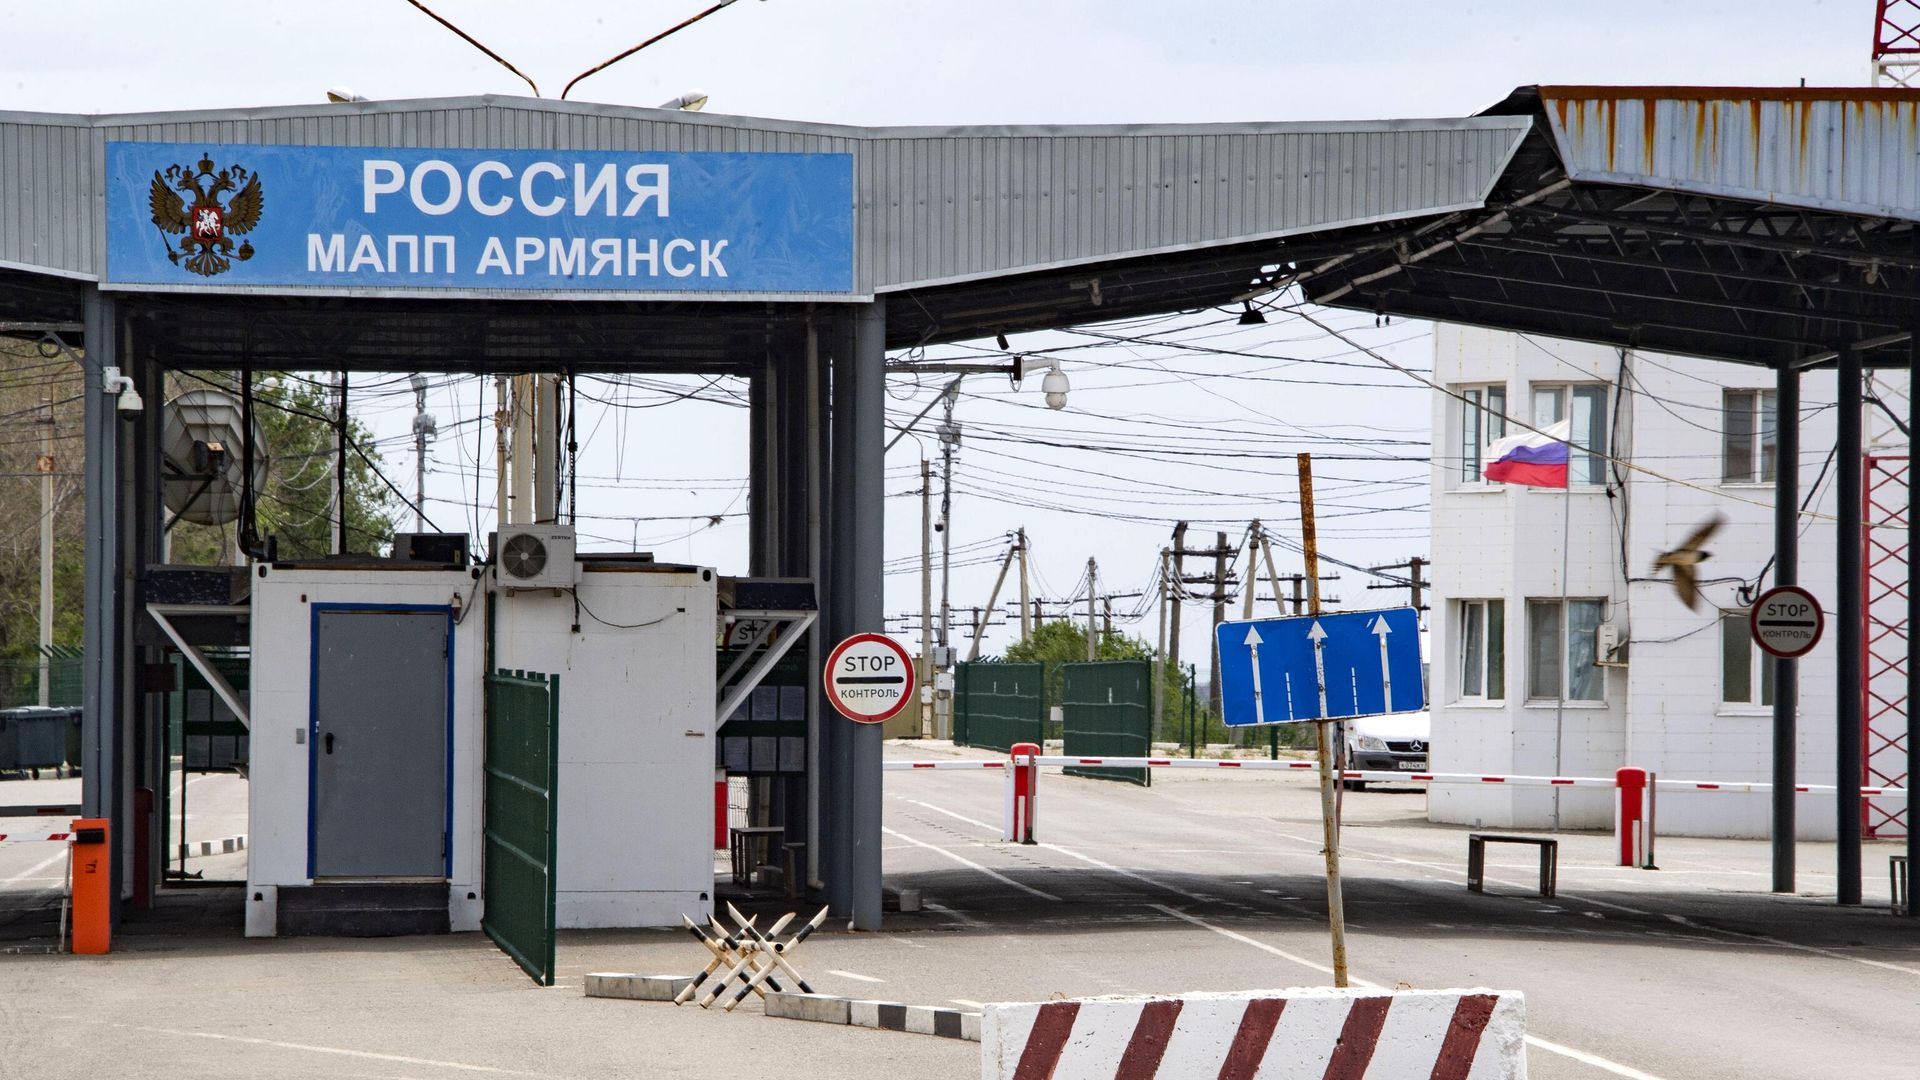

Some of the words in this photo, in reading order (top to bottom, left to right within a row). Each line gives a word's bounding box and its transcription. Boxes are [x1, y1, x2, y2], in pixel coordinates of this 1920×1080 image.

[364, 160, 669, 217] РОССИЯ
[308, 233, 455, 273] МАПП
[476, 237, 728, 278] АРМЯНСК
[1767, 603, 1808, 616] STOP
[1763, 630, 1811, 638] КОНТРОЛЬ
[845, 656, 895, 671] STOP
[841, 689, 899, 698] КОНТРОЛЬ
